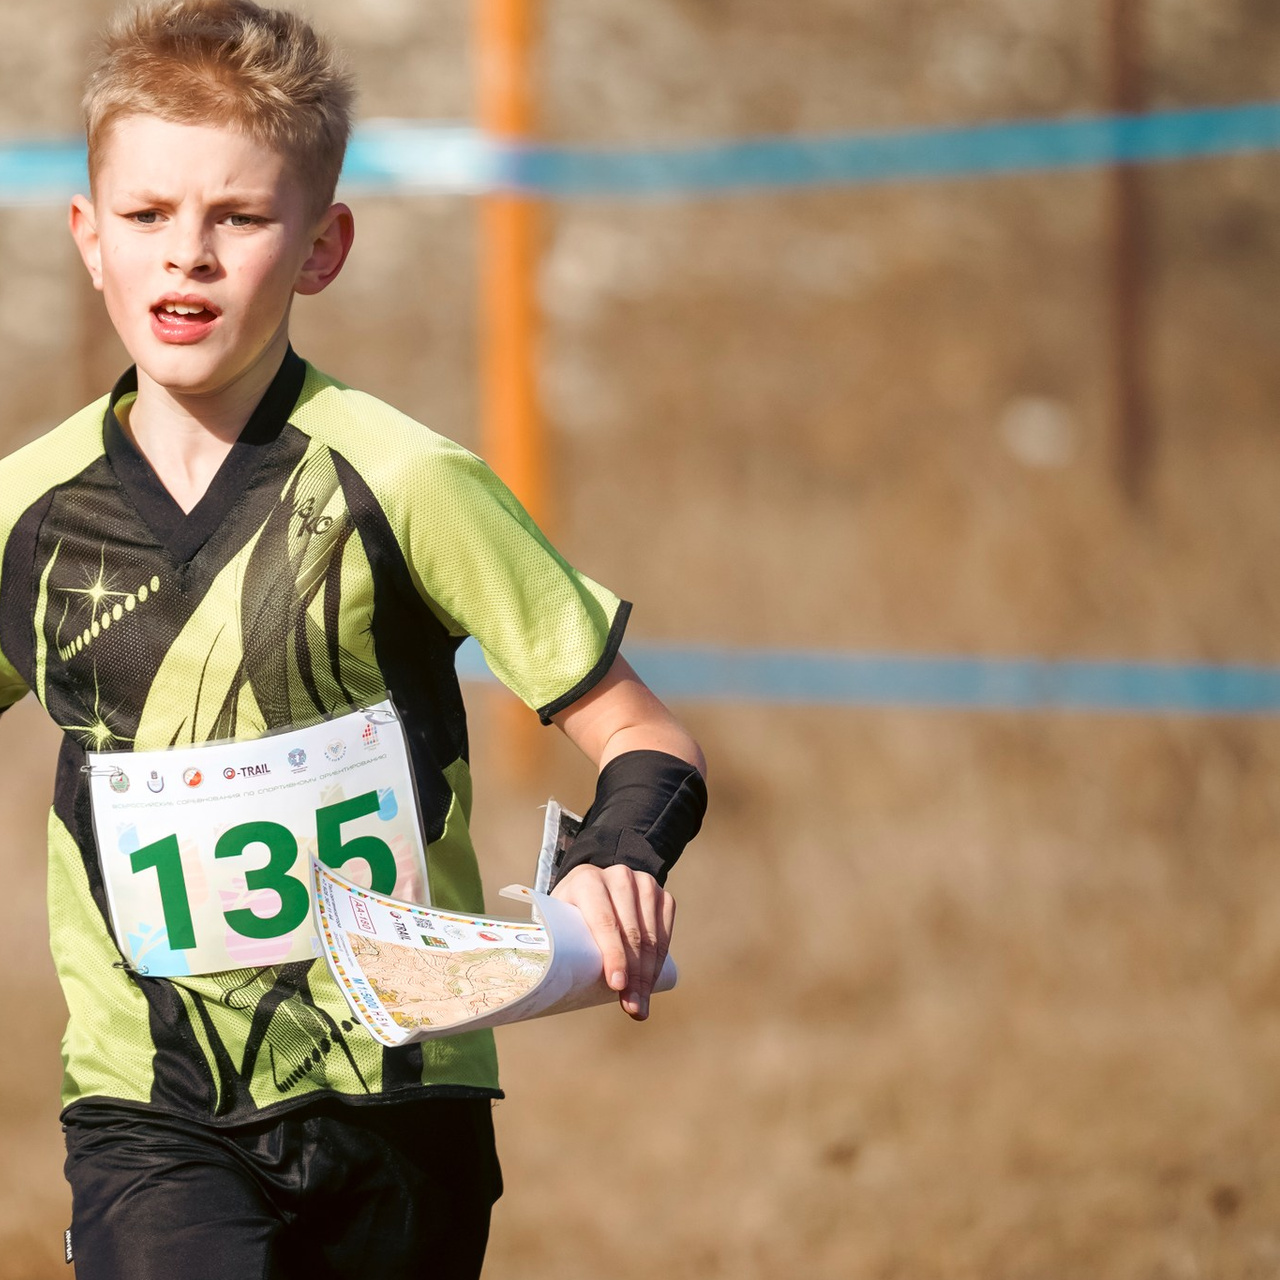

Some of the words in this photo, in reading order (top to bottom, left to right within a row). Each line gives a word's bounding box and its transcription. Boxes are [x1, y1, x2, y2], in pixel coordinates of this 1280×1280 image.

[257, 777, 317, 795] СПОРТИВНОМУ
[319, 753, 387, 780] ОРИЕНТИРОВАНИЮ
[130, 790, 397, 951] 135
